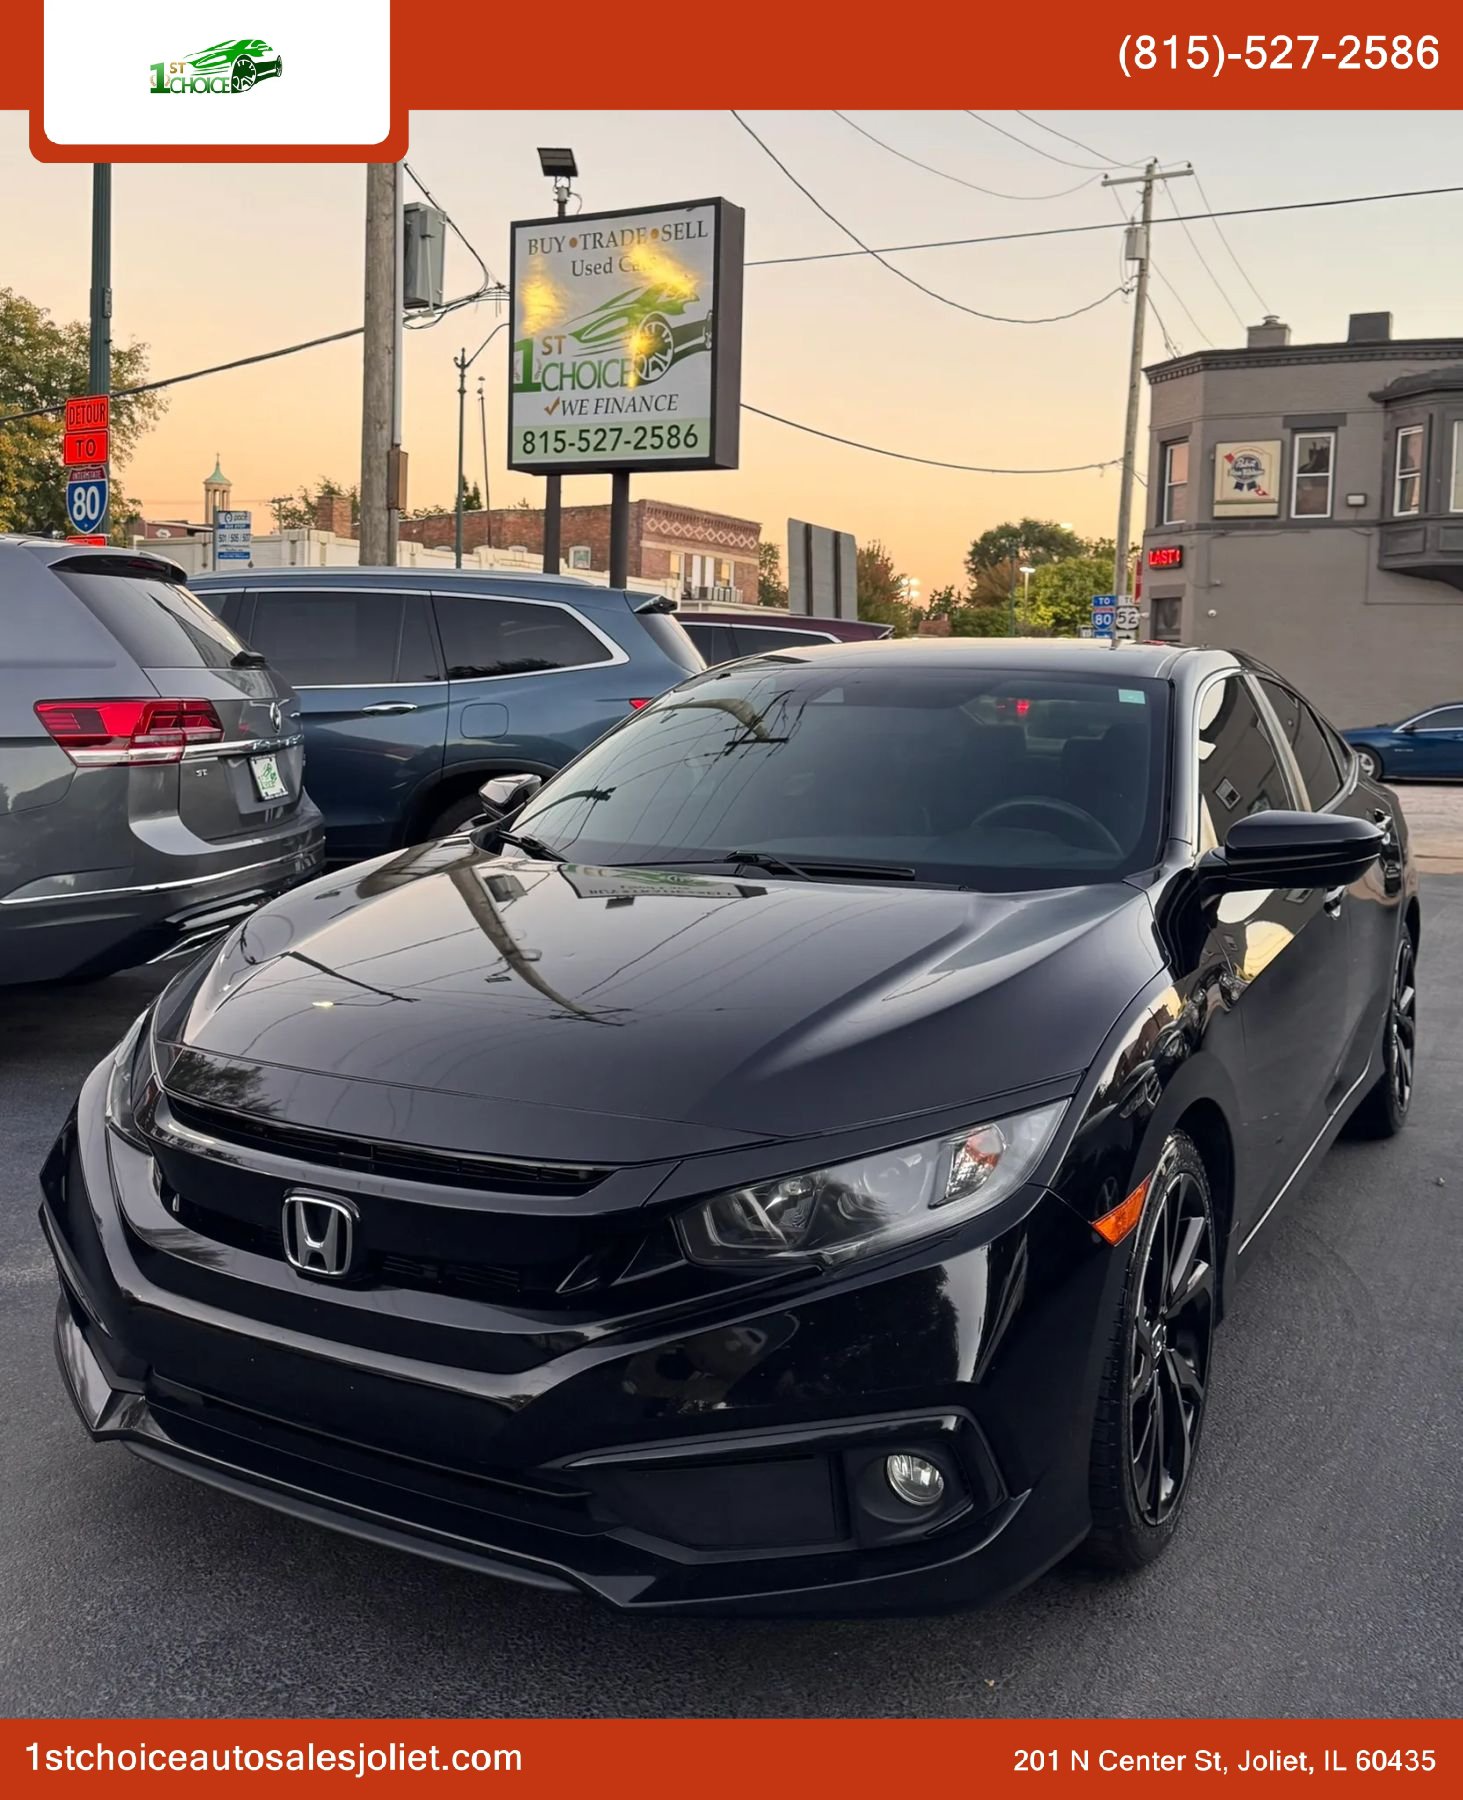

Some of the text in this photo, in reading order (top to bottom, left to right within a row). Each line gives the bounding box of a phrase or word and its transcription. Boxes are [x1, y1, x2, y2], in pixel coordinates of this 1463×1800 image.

[528, 220, 709, 255] BUY TRADE SELL
[571, 256, 613, 277] Used
[69, 402, 106, 426] DETOUR
[561, 394, 679, 416] WE FINANCE
[75, 439, 97, 458] TO
[522, 424, 699, 455] 815-527-2586
[72, 486, 100, 522] 80
[1148, 548, 1176, 566] LAST
[1098, 597, 1111, 605] TO
[1094, 613, 1112, 626] 80
[1117, 611, 1138, 625] 52
